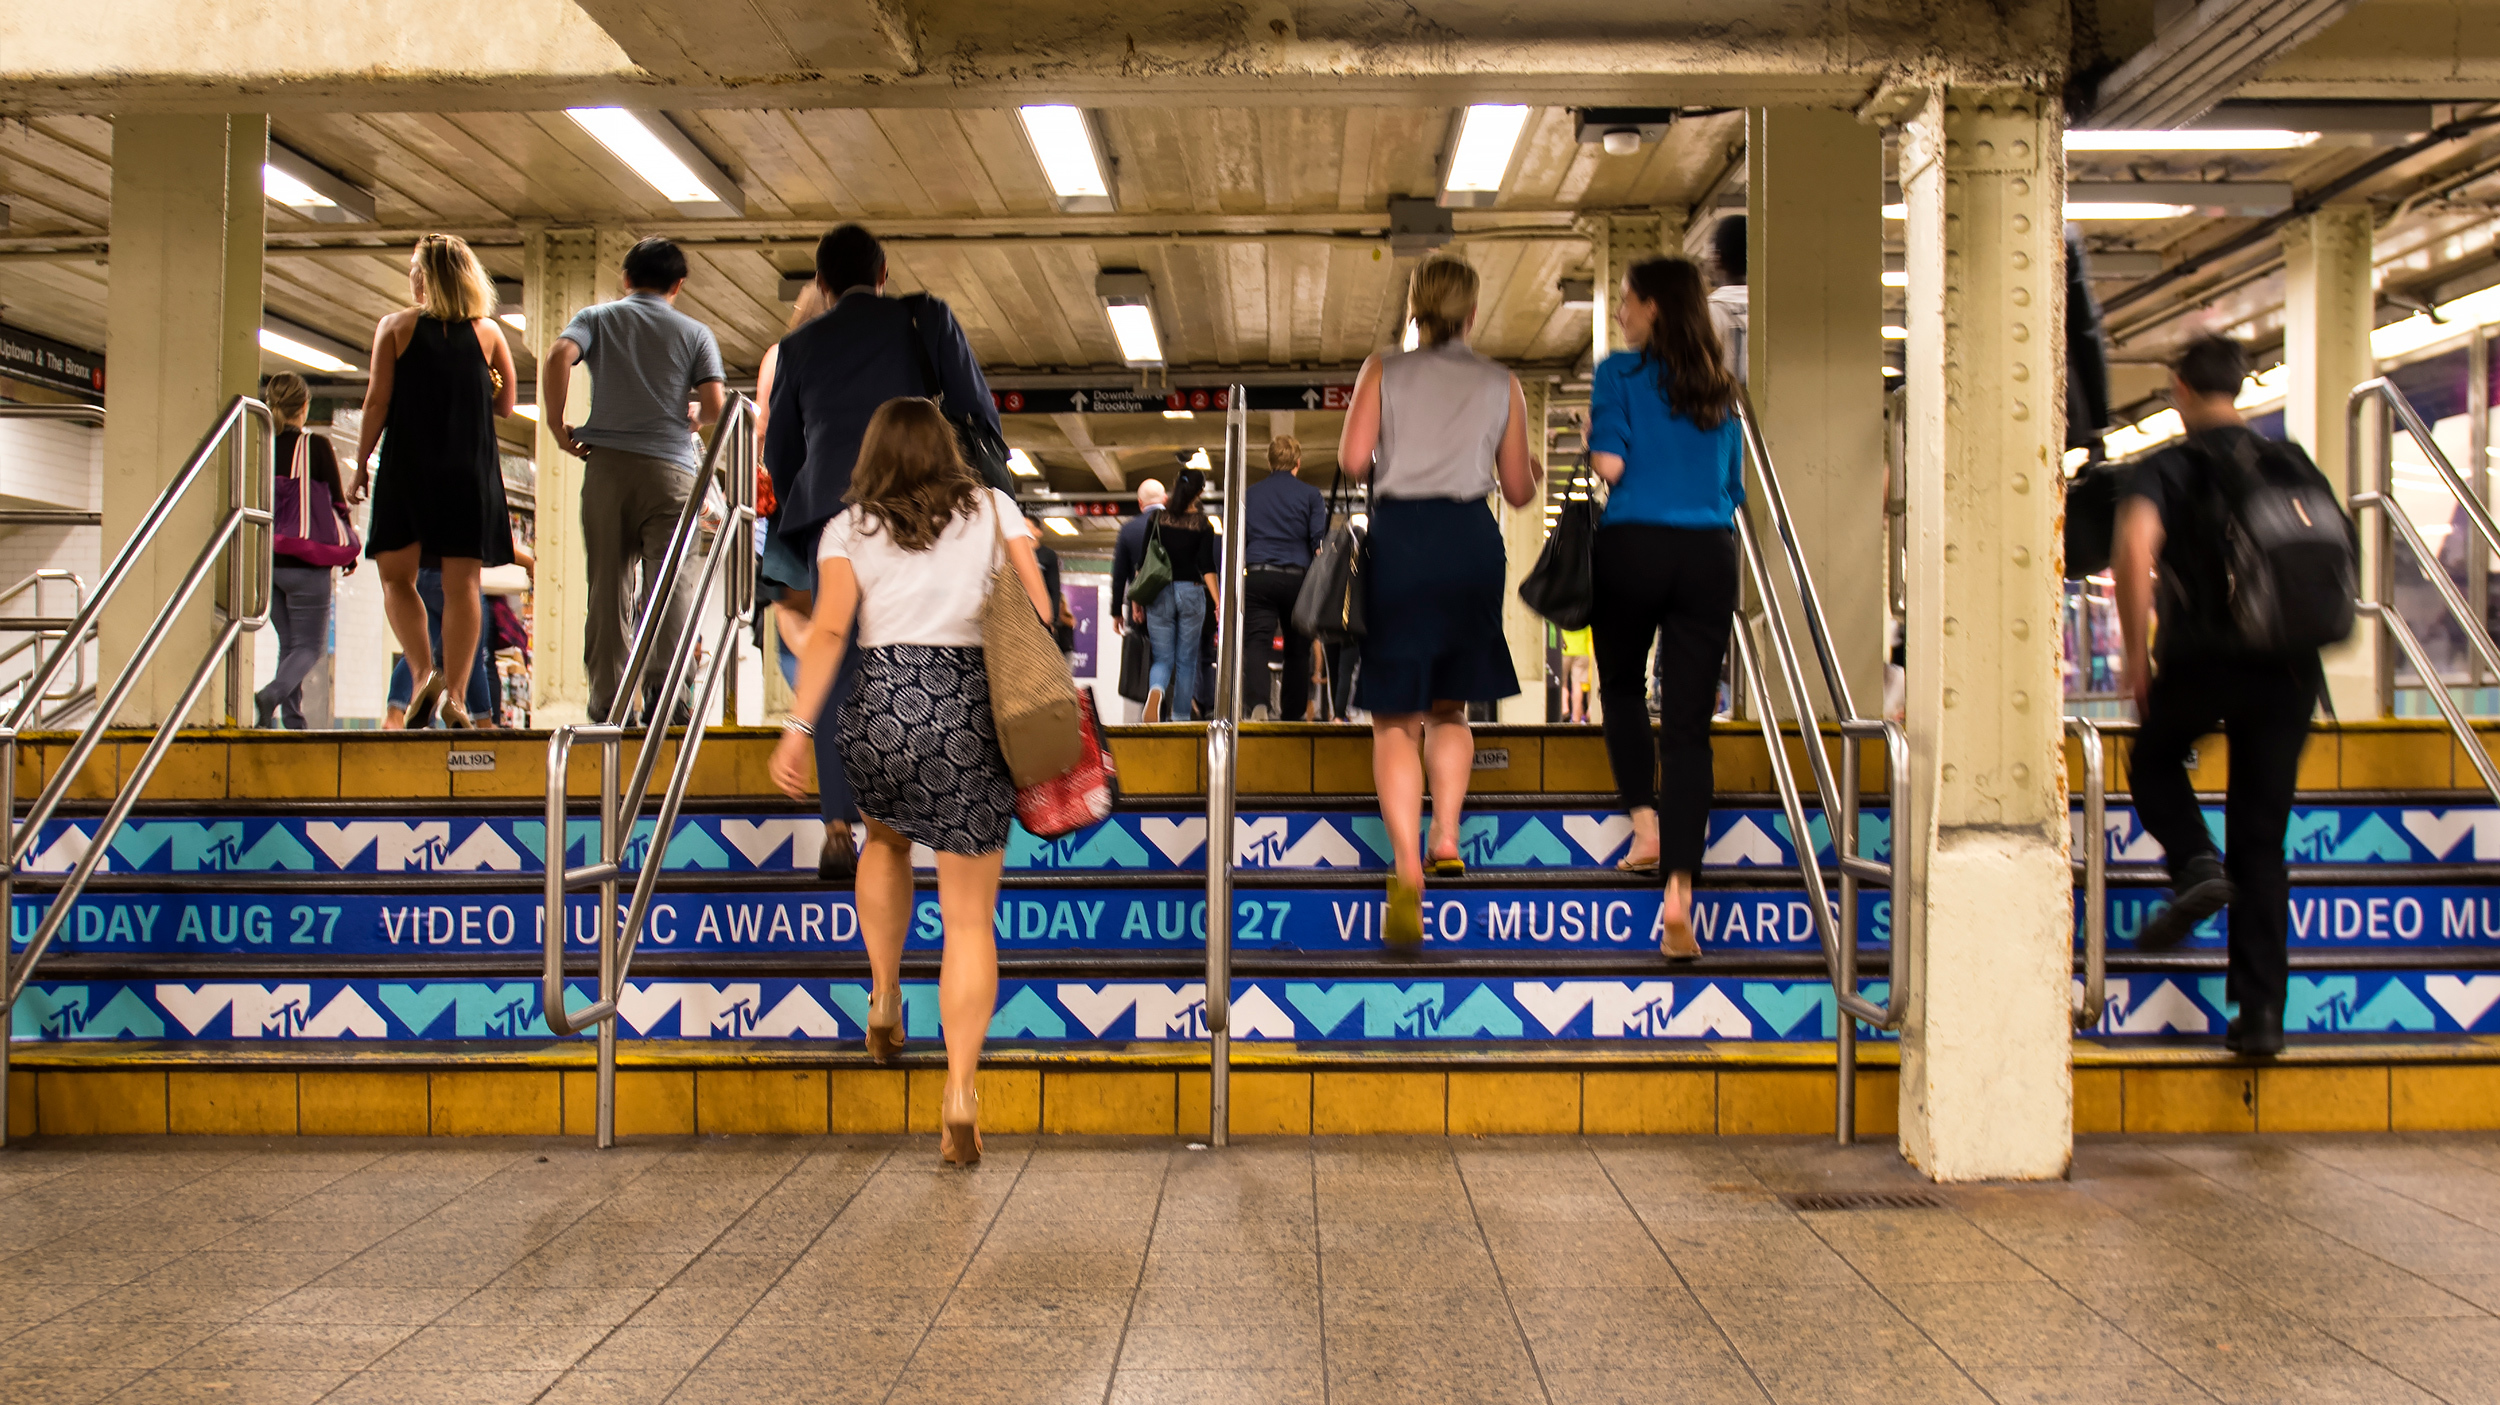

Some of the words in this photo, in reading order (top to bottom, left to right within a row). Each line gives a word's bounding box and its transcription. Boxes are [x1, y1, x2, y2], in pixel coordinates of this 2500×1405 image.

[0, 338, 34, 363] Uptown
[36, 349, 43, 366] &
[46, 352, 62, 372] The
[65, 358, 90, 379] Bronx
[1093, 400, 1142, 412] Brooklyn
[1323, 386, 1352, 408] Ex
[177, 905, 272, 943] AUG
[289, 905, 342, 944] 27
[382, 904, 516, 944] VIDEO
[694, 903, 858, 943] AWARD
[915, 901, 1106, 941] SNDAY
[1237, 901, 1291, 940] 27
[1488, 900, 1632, 942] MUSIC
[2287, 897, 2424, 941] VIDEO
